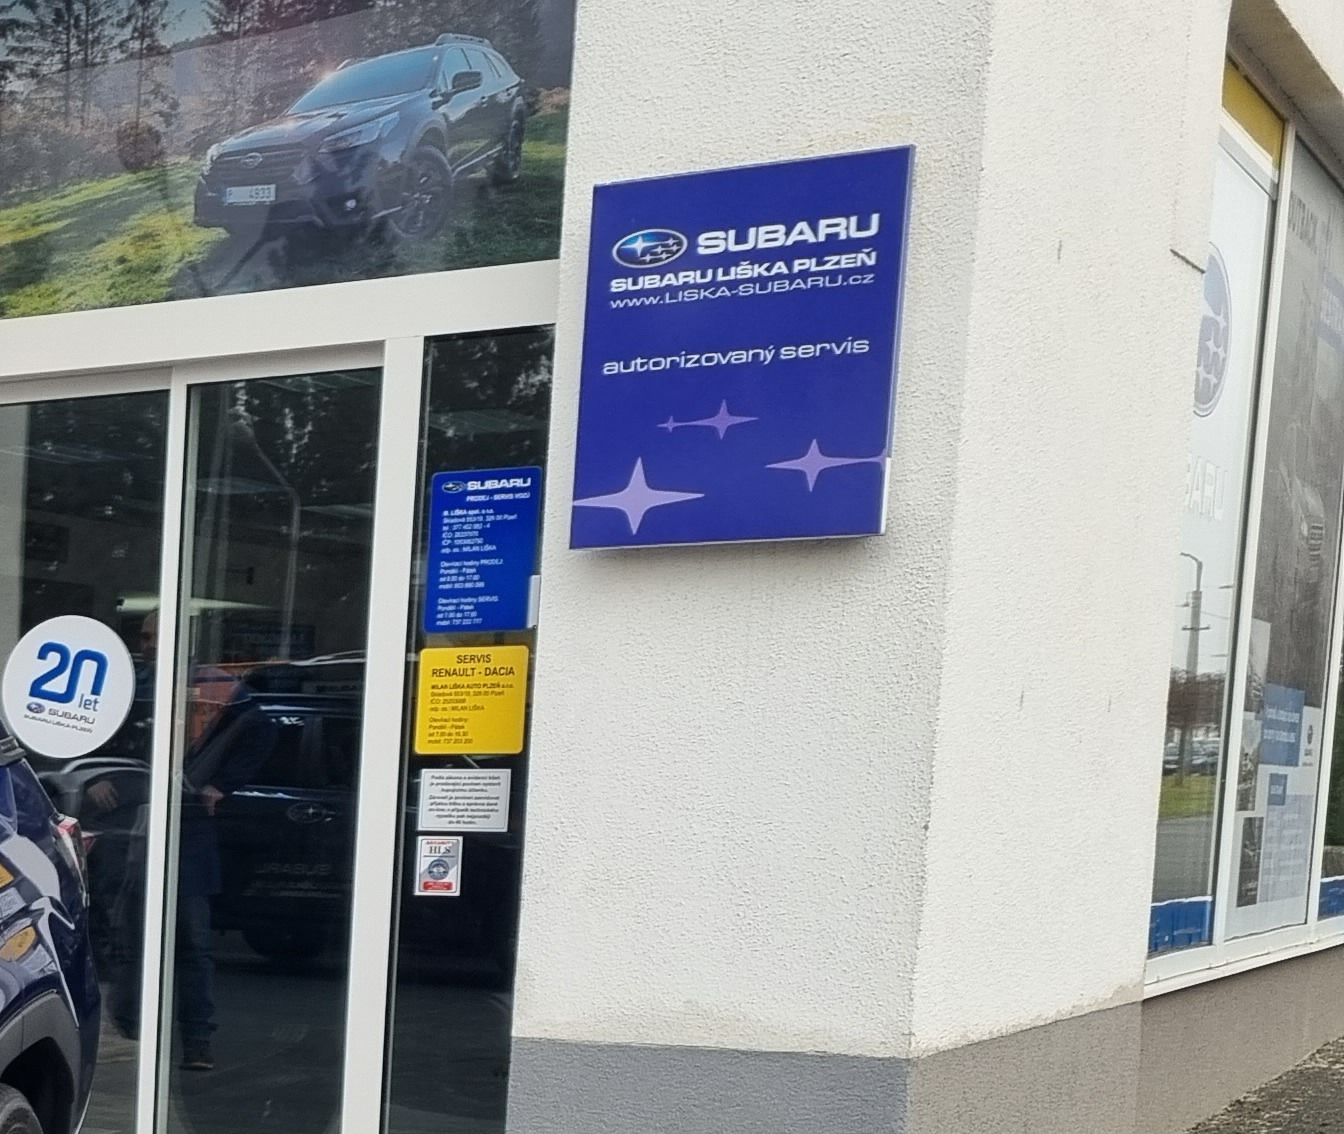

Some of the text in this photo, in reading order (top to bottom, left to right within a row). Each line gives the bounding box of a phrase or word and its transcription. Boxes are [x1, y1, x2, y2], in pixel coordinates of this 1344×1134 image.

[696, 213, 880, 256] SUBARU
[610, 249, 876, 292] SUBARU LIŠKA PLZEŇ
[610, 272, 875, 309] www.LISKA-SUBARU.cz
[603, 336, 870, 376] autorizovaný servis
[467, 478, 531, 491] SUBARU
[456, 654, 491, 664] SERVIS
[432, 668, 476, 677] RENAULT
[485, 667, 515, 676] DACIA
[78, 694, 100, 712] let
[48, 708, 95, 725] SUBARU
